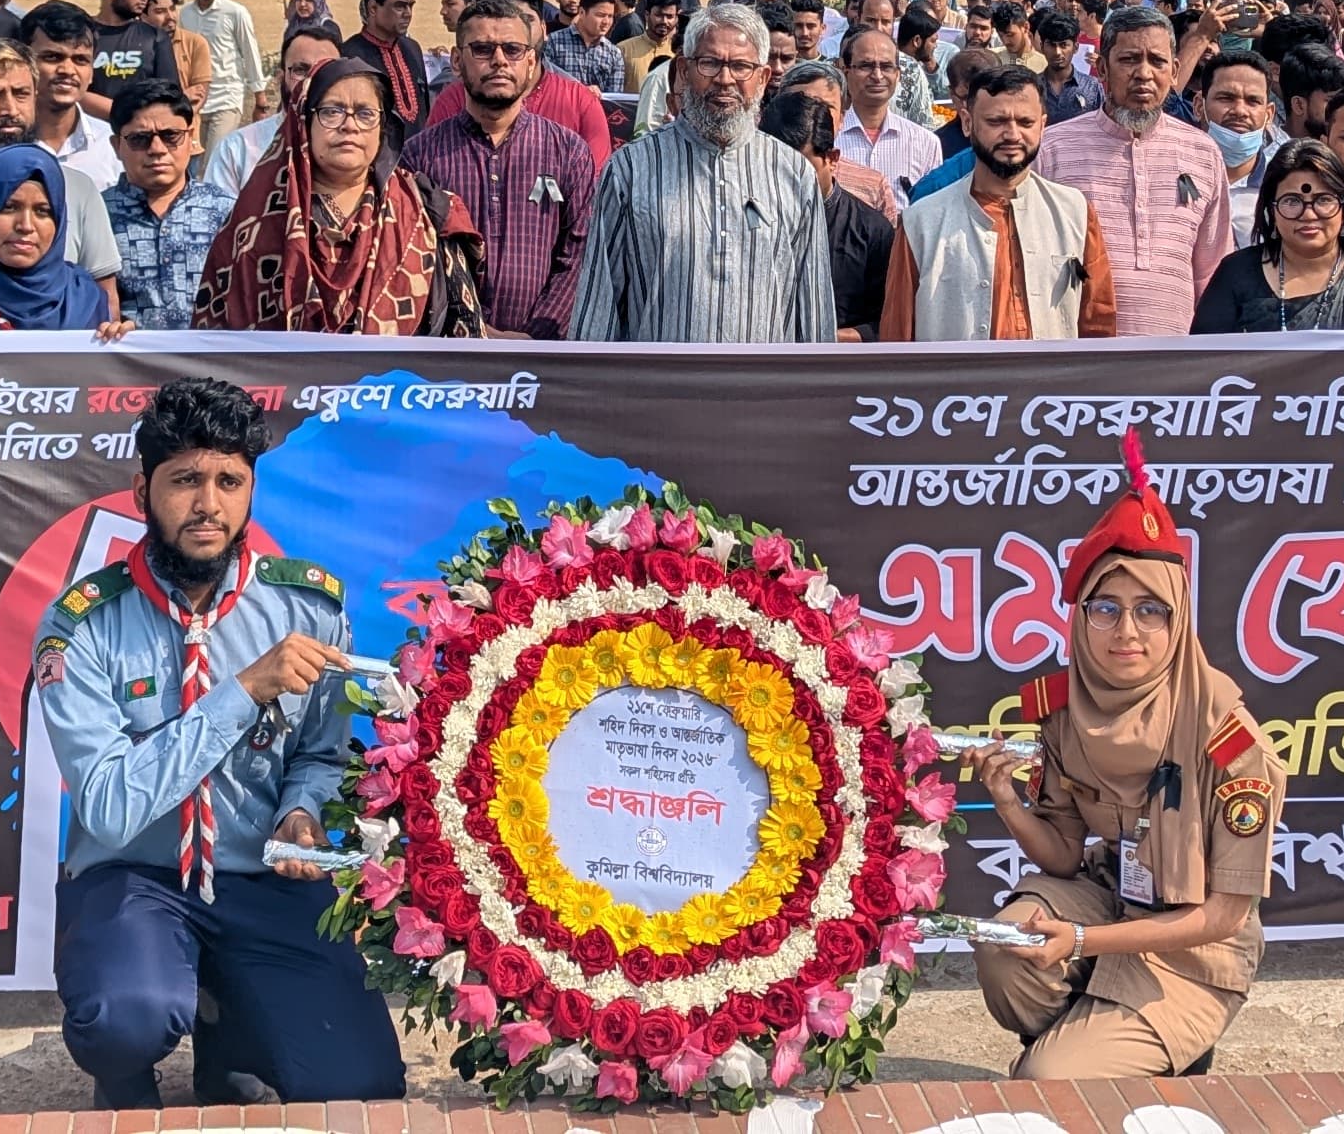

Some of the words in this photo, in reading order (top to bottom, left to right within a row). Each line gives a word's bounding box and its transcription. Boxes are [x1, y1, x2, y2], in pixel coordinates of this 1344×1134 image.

[293, 384, 395, 422] একুশে
[401, 371, 540, 410] ফেব্রুয়ারি
[849, 395, 1007, 437] ২১শে
[1021, 376, 1261, 437] ফেব্রুয়ারি
[848, 444, 1124, 507] আন্তর্জাতিক
[599, 715, 625, 735] শহিদ
[629, 719, 656, 738] দিবস
[661, 725, 668, 739] ও
[606, 740, 648, 761] মাতৃভাষা
[651, 741, 678, 762] দিবস
[681, 749, 718, 767] ২০২৬
[587, 786, 728, 826] শ্রদ্ধাঞ্জলি
[1222, 780, 1266, 796] BNCC
[586, 857, 628, 881] কুমিল্লা
[633, 861, 715, 889] বিশ্ববিদ্যালয়
